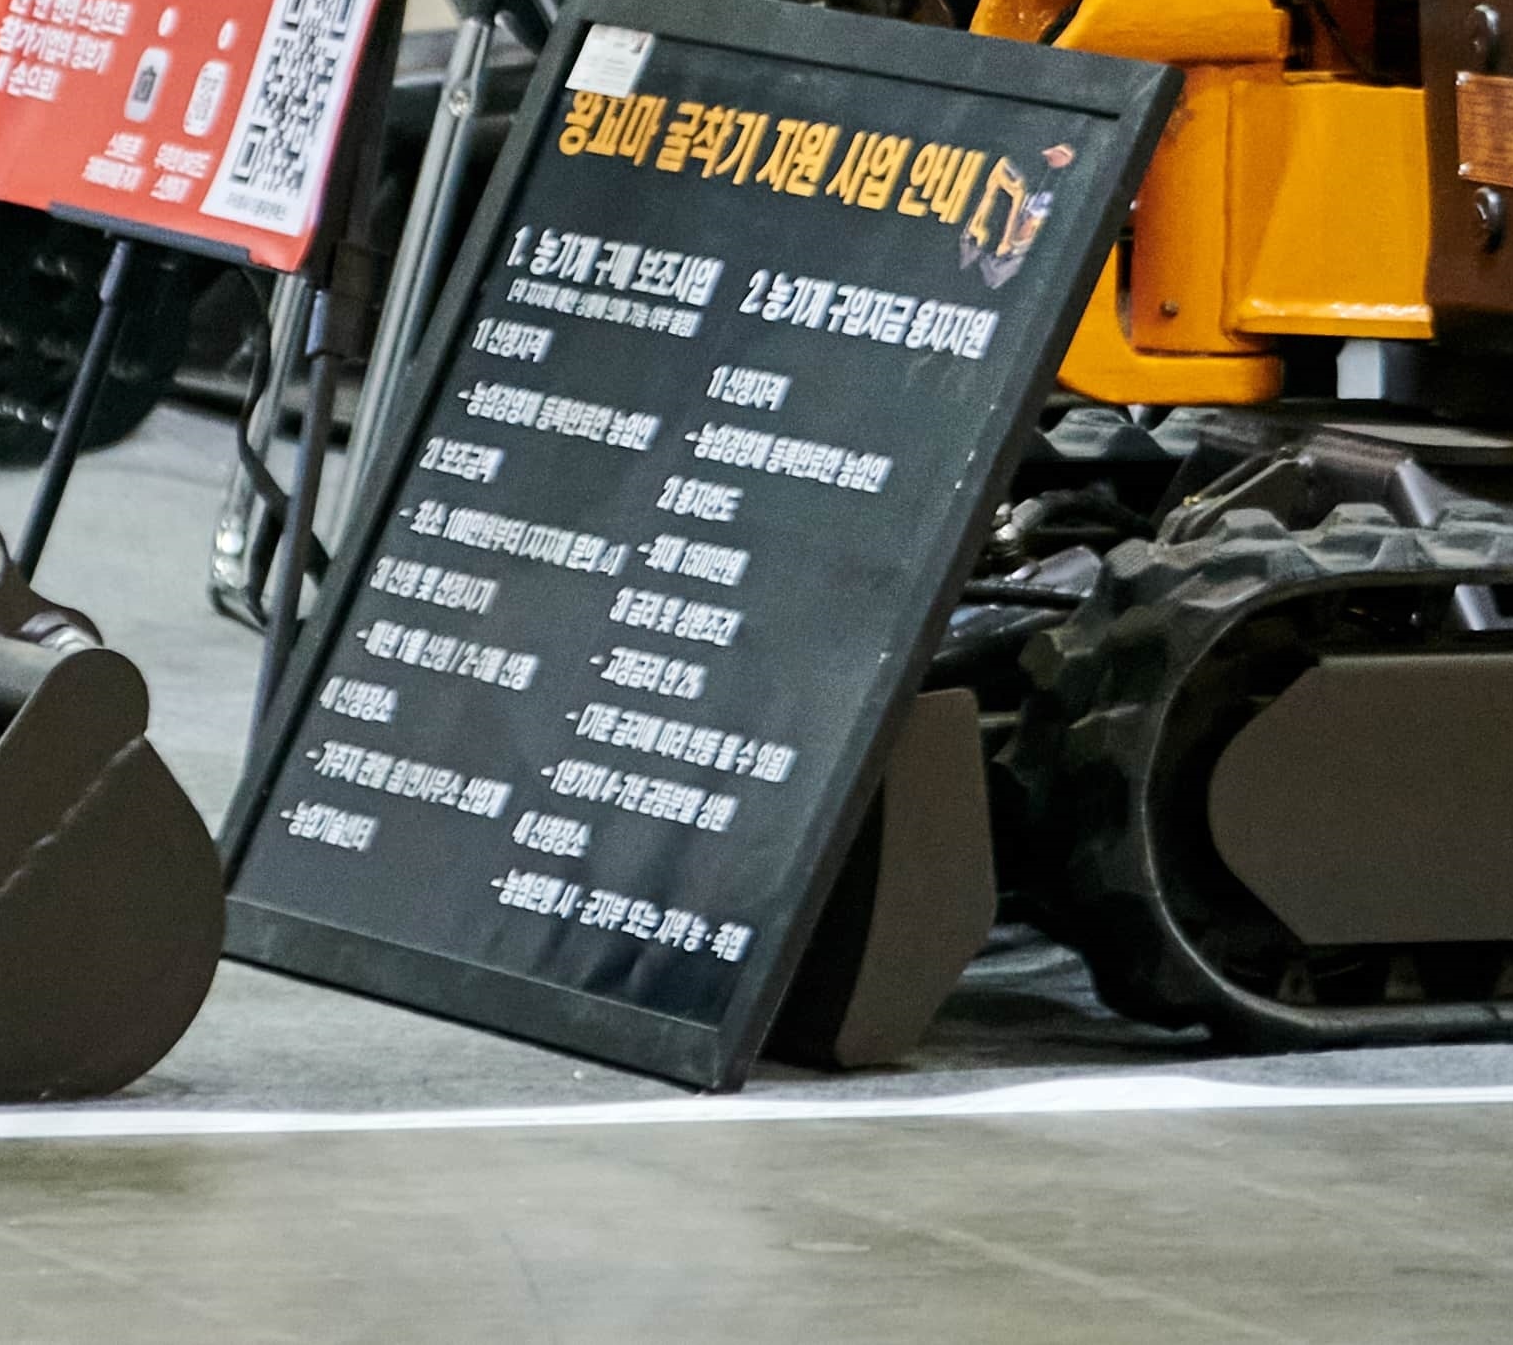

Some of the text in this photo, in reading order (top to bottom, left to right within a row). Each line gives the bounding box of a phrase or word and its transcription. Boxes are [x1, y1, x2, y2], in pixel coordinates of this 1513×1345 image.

[656, 102, 768, 184] 굴착기
[755, 119, 839, 196] 지원
[825, 131, 910, 209] 사업
[897, 143, 984, 223] 안내
[529, 228, 600, 282] 농기계
[594, 241, 642, 290] 구매
[631, 249, 723, 305] 보조사업
[486, 321, 552, 362] 신청자격
[827, 285, 917, 343] 구입자금
[905, 300, 998, 358] 융자지원
[721, 368, 790, 410] 신청자격
[678, 542, 748, 585] 1500만원
